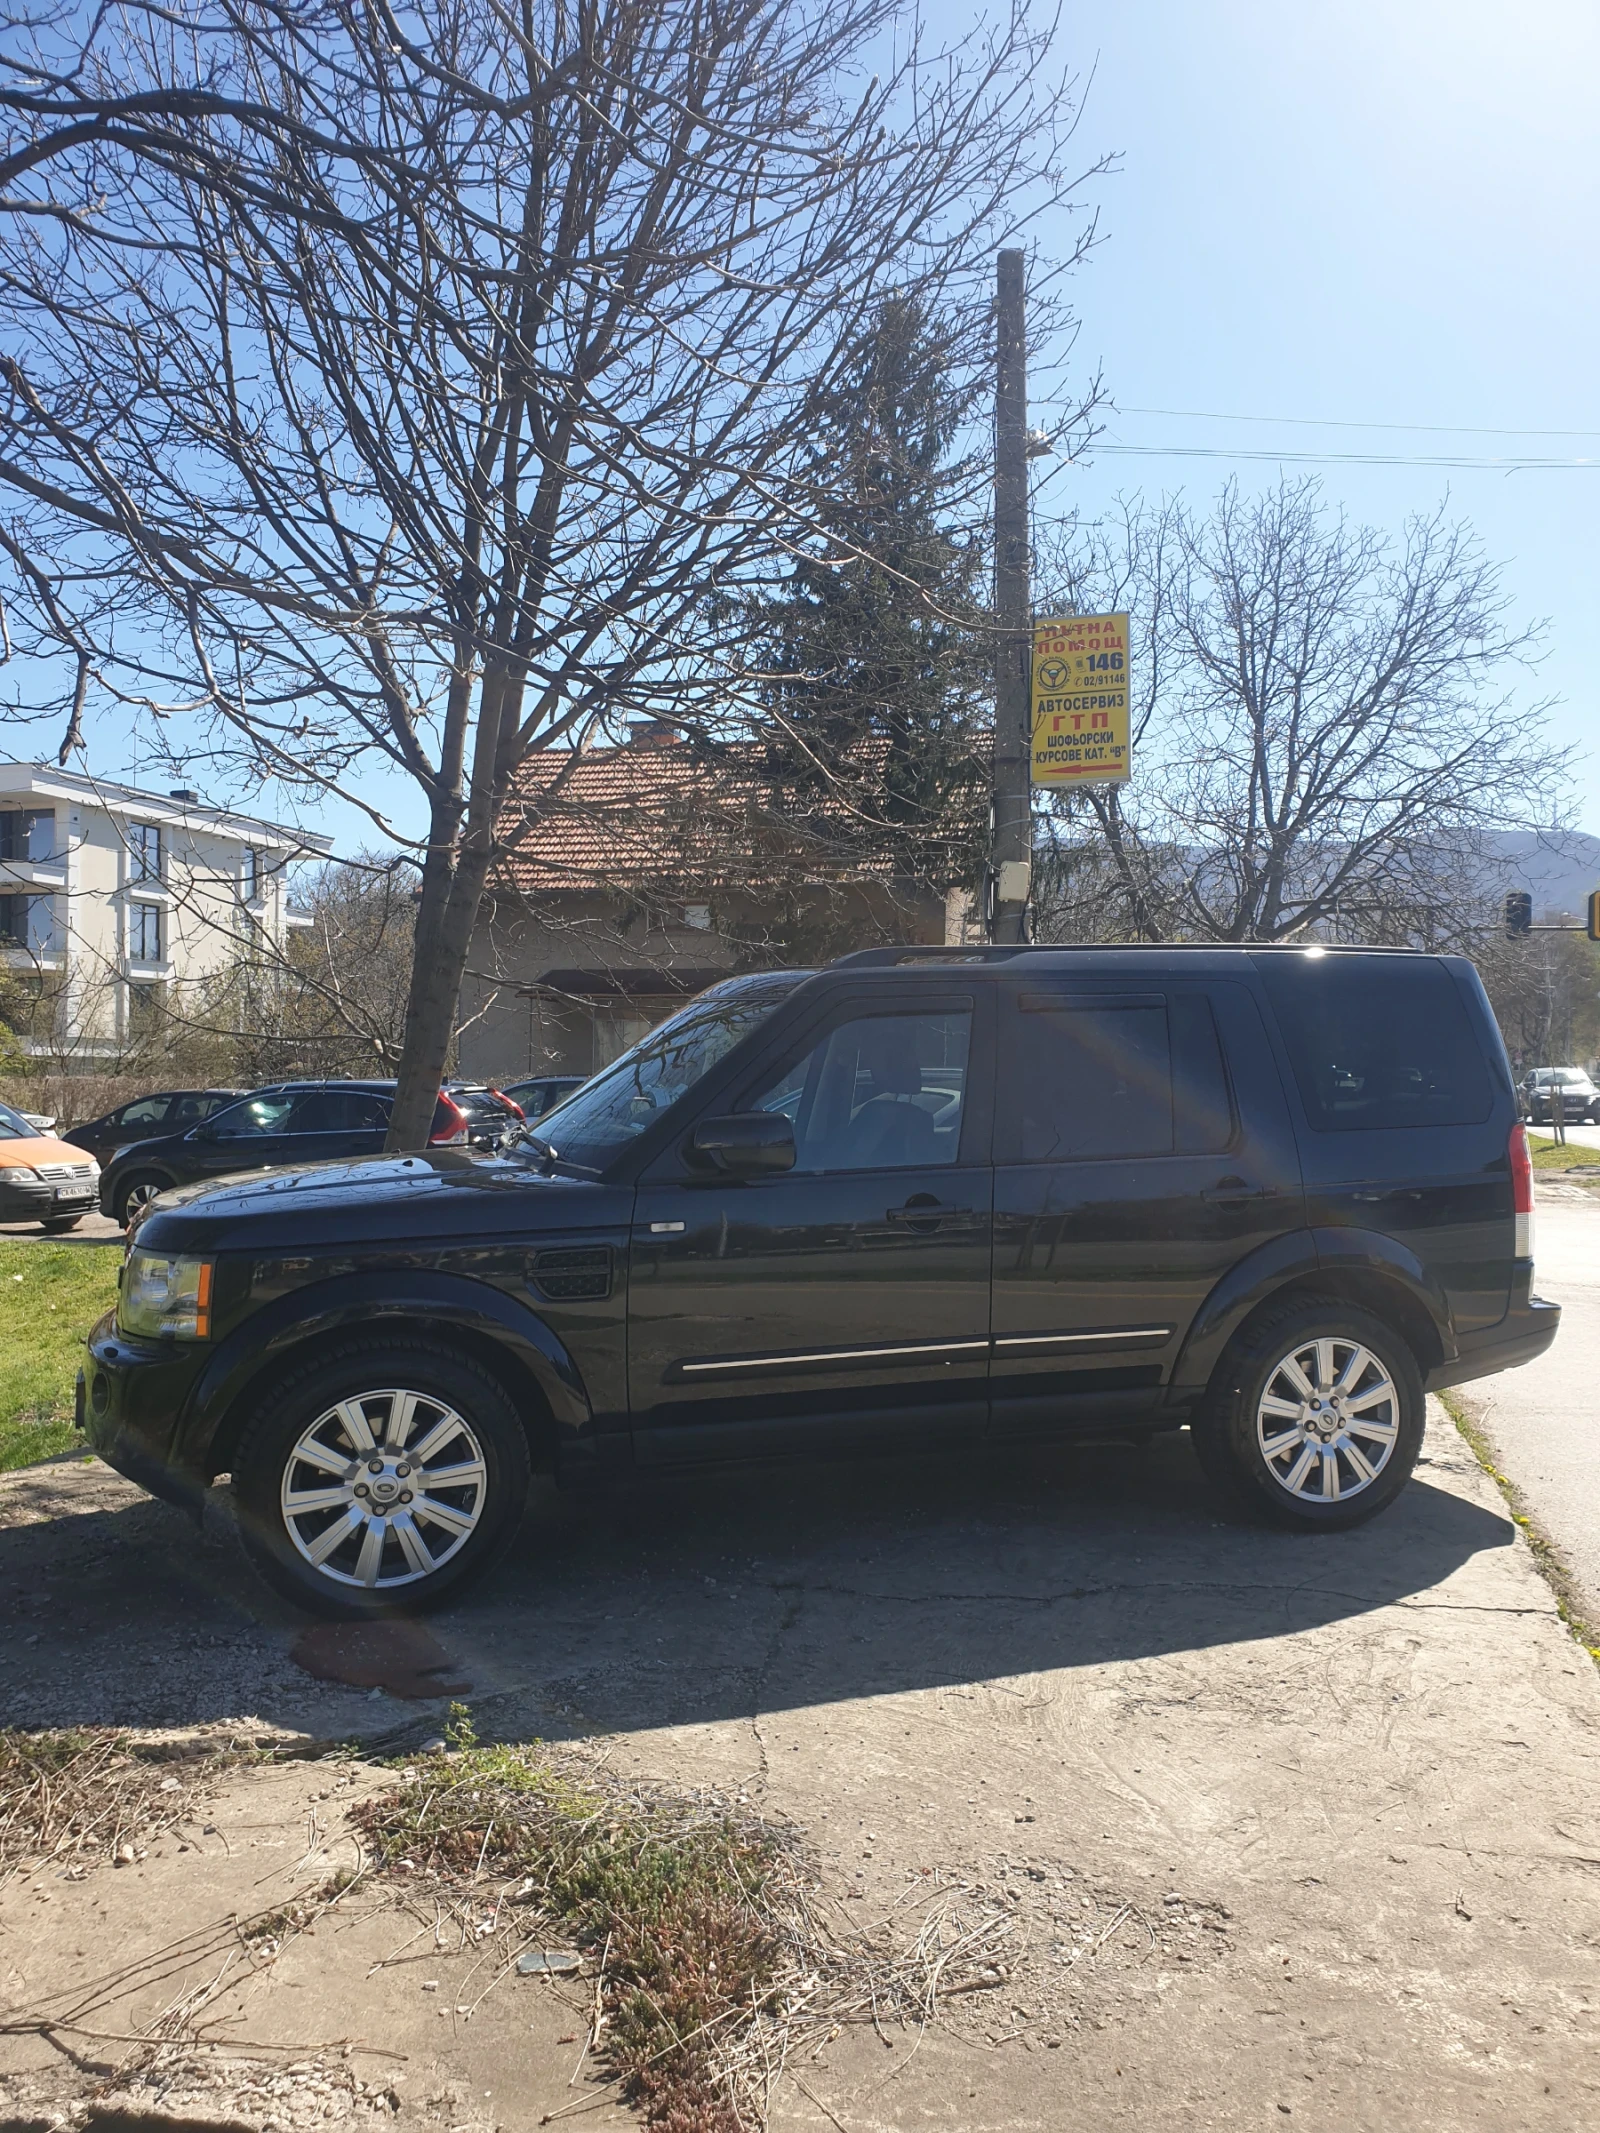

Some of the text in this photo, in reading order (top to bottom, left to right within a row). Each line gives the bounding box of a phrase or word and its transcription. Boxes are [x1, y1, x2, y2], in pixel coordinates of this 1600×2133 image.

[1044, 621, 1115, 638] ПЪТНА
[1037, 636, 1123, 654] ПОМОЩ
[1086, 652, 1124, 672] 146
[1083, 673, 1125, 688] 02/91146
[1037, 693, 1124, 713] АВТОСЕРВИЗ
[1053, 712, 1109, 732] ГТП
[1047, 731, 1114, 748] ШОФЬОРСКИ
[1036, 749, 1082, 764] КУРСОВЕ
[1085, 747, 1108, 761] КАТ.
